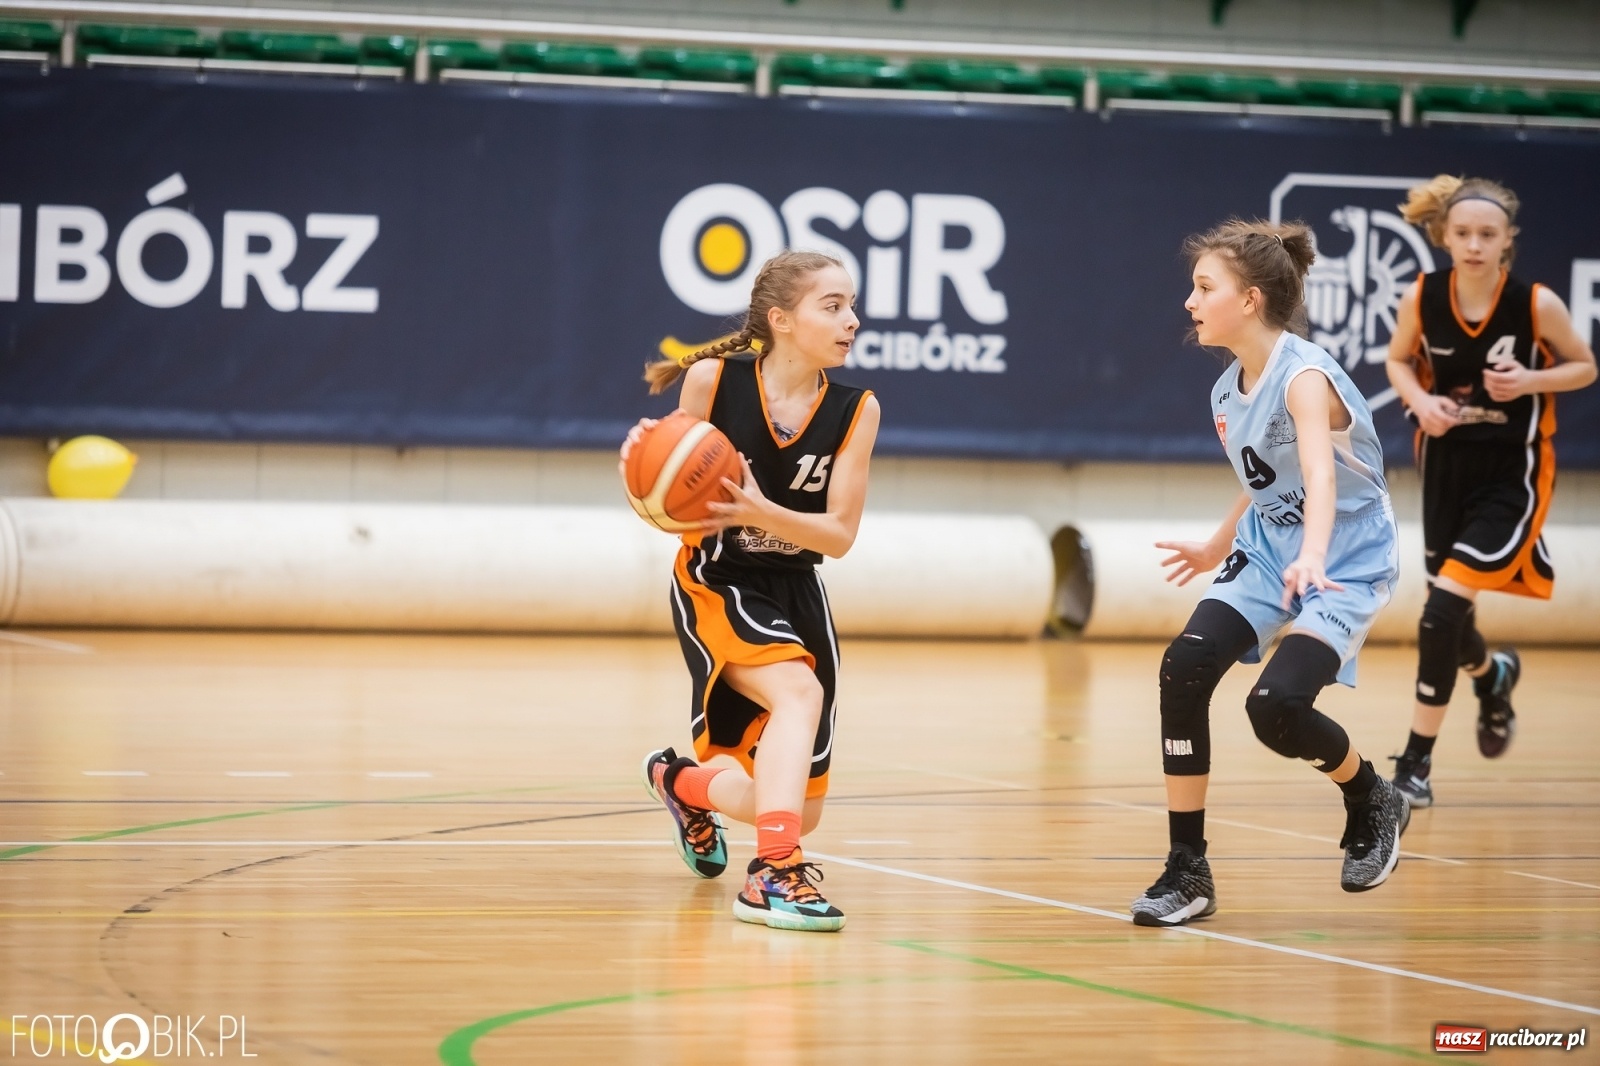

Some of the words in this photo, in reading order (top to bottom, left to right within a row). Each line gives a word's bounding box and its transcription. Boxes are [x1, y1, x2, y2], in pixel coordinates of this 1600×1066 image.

[842, 323, 1007, 373] CIBÓRZ
[1486, 335, 1517, 364] 4
[789, 454, 832, 493] 15
[1241, 445, 1277, 490] 9
[1213, 549, 1250, 584] 9
[1172, 739, 1193, 756] NBA
